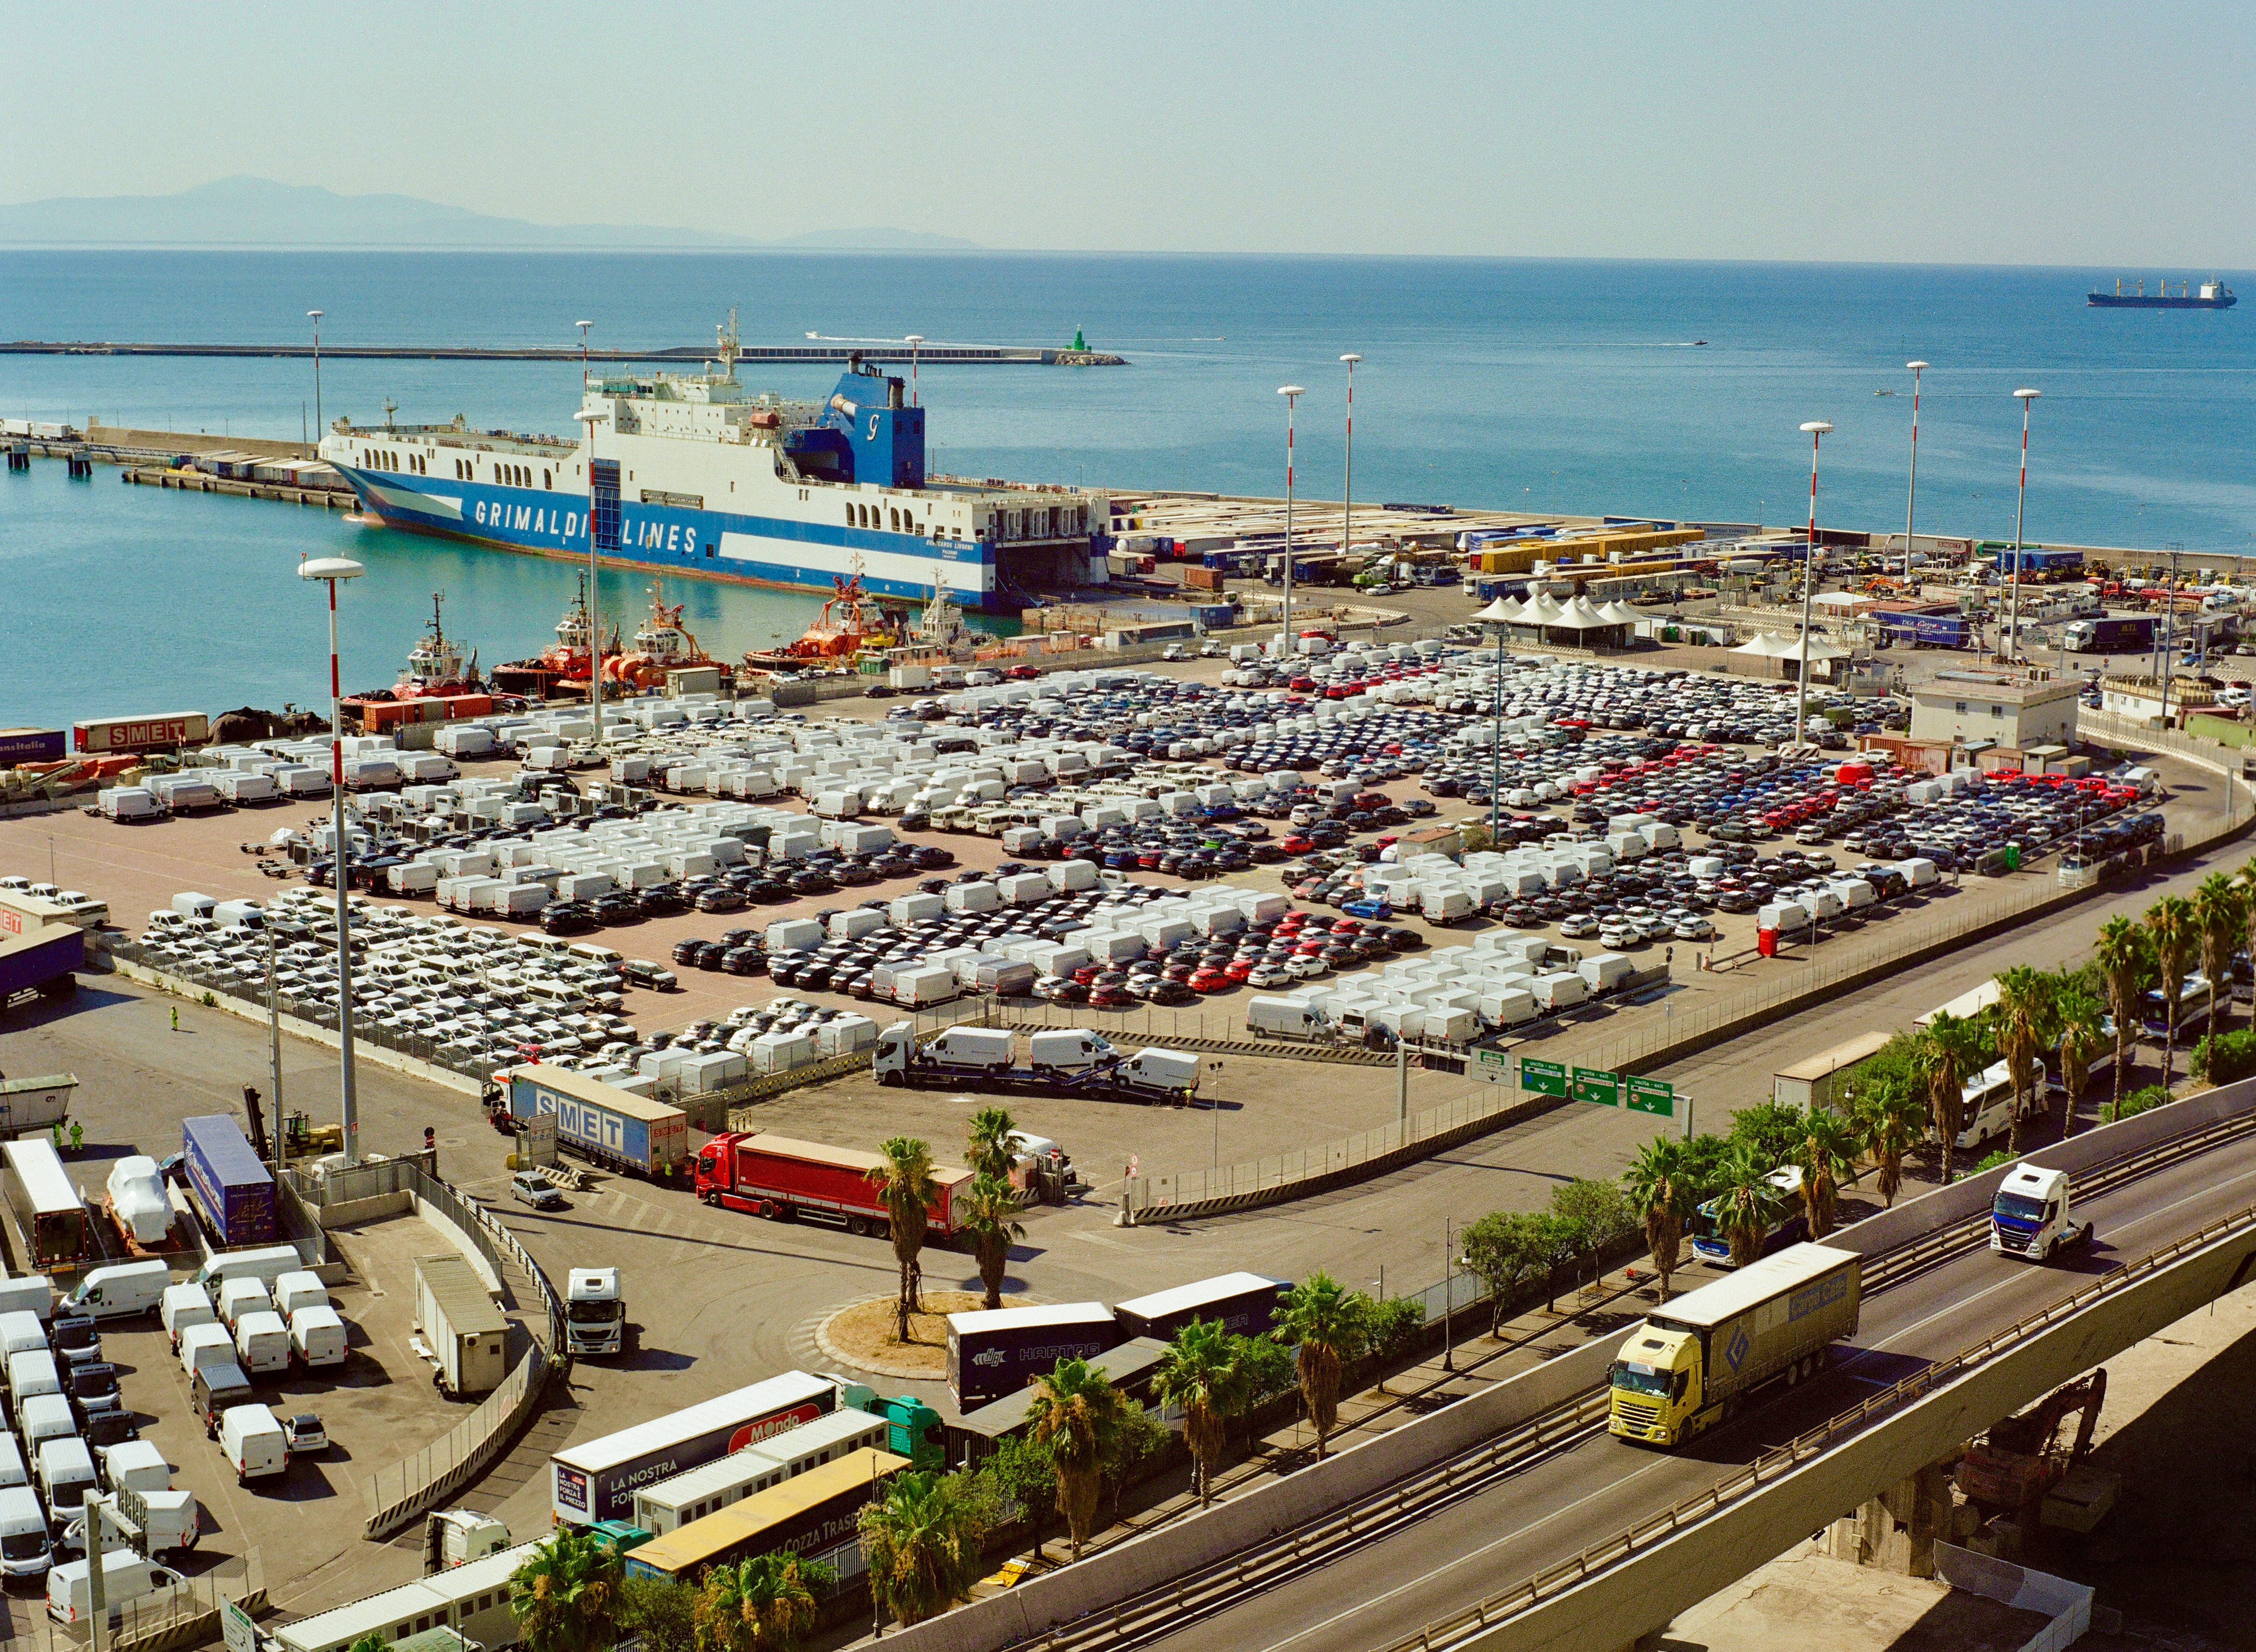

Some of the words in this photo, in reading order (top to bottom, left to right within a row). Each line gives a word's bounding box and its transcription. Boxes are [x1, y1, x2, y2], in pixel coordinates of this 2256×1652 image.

[476, 500, 588, 538] GRIMALDI
[623, 519, 696, 553] LINES
[112, 721, 183, 743] SMET
[539, 1095, 621, 1146] SMET
[654, 1123, 684, 1138] SMET
[1020, 1342, 1100, 1361] HARTOG
[611, 1477, 626, 1492] LA
[629, 1459, 678, 1486] NOSTRA
[559, 1479, 581, 1492] NOSTRA
[560, 1486, 576, 1497] FORZA
[565, 1496, 586, 1509] PREZZO
[651, 1521, 662, 1537] UN
